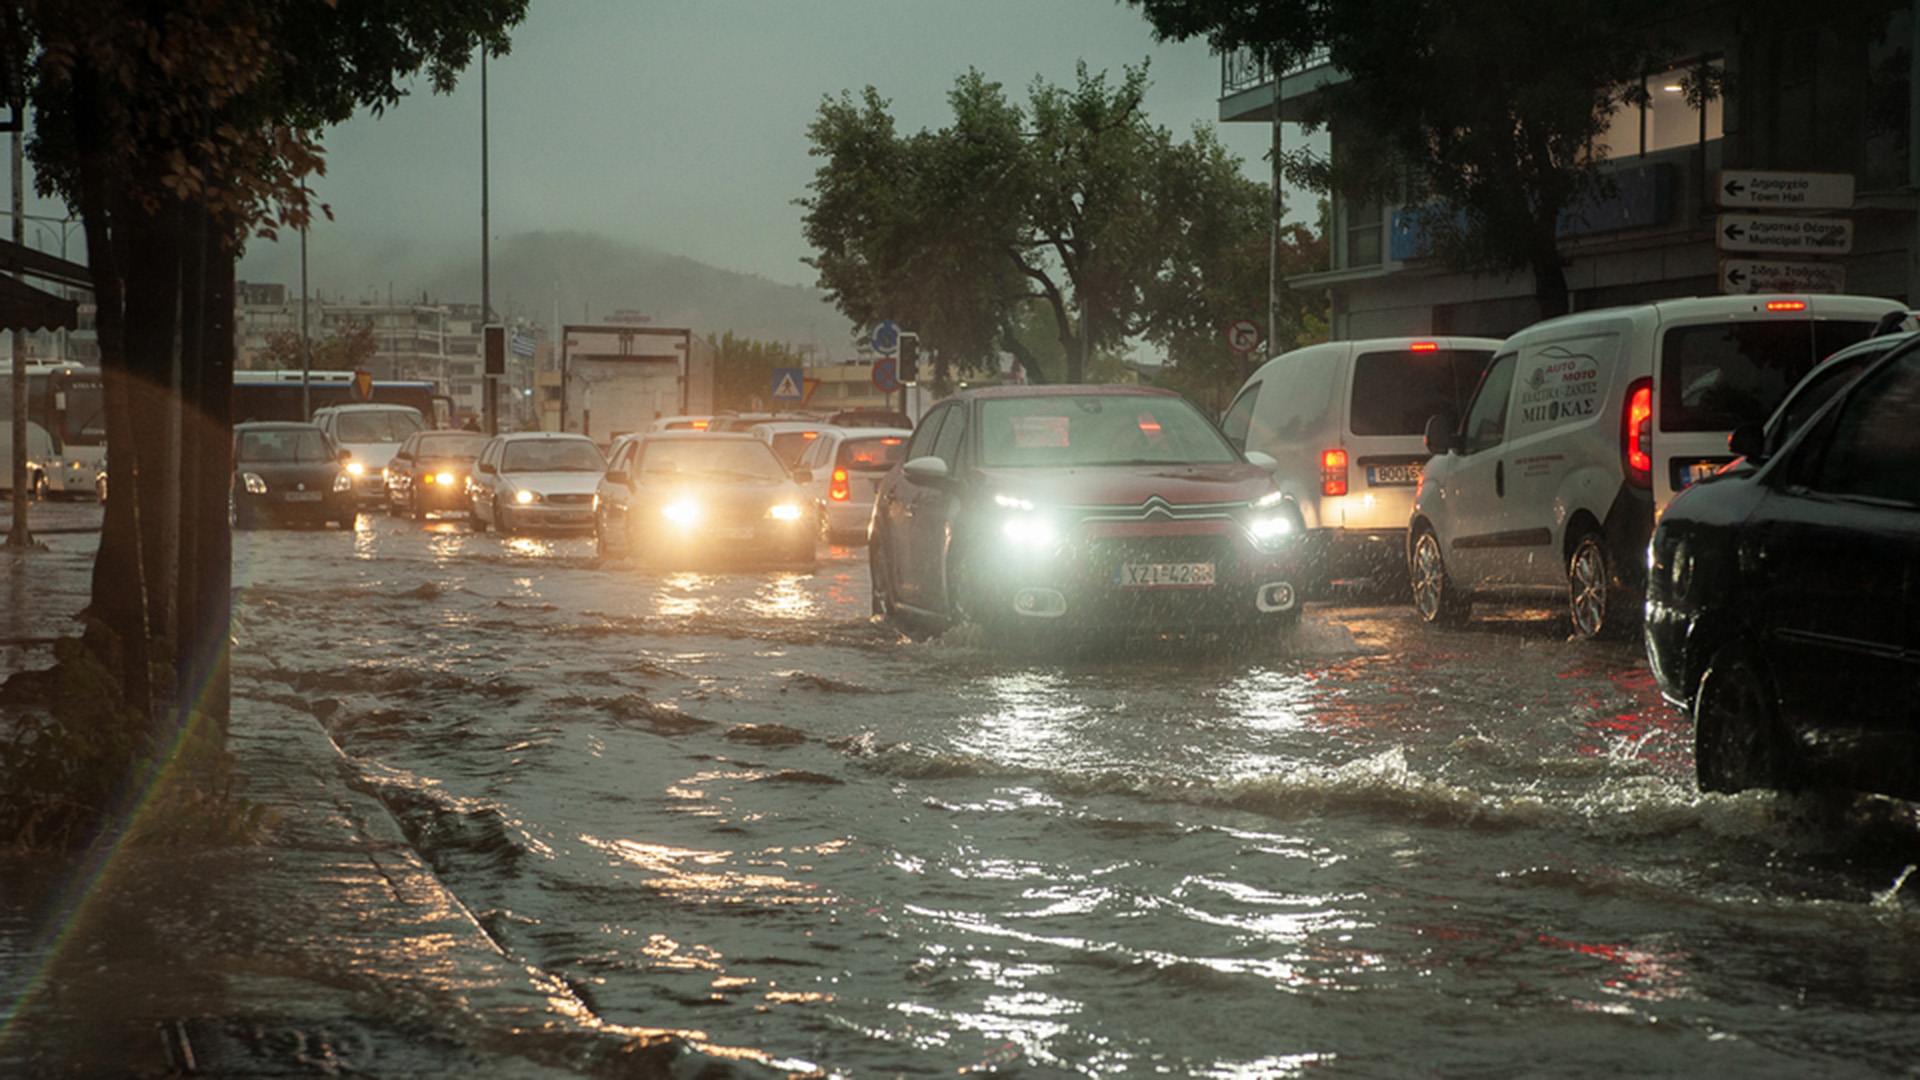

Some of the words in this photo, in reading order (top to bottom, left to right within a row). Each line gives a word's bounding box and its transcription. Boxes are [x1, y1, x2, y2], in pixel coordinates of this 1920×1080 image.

[1750, 177, 1809, 190] Δημαρχείο
[1750, 191, 1780, 202] Town
[1782, 192, 1805, 202] Hall
[1750, 220, 1801, 235] Δημοτικό
[1749, 234, 1801, 247] Municipal
[1545, 360, 1577, 374] AUTO
[1562, 369, 1597, 382] MOTO
[1522, 399, 1595, 423] ΜΠΟΚΑΣ
